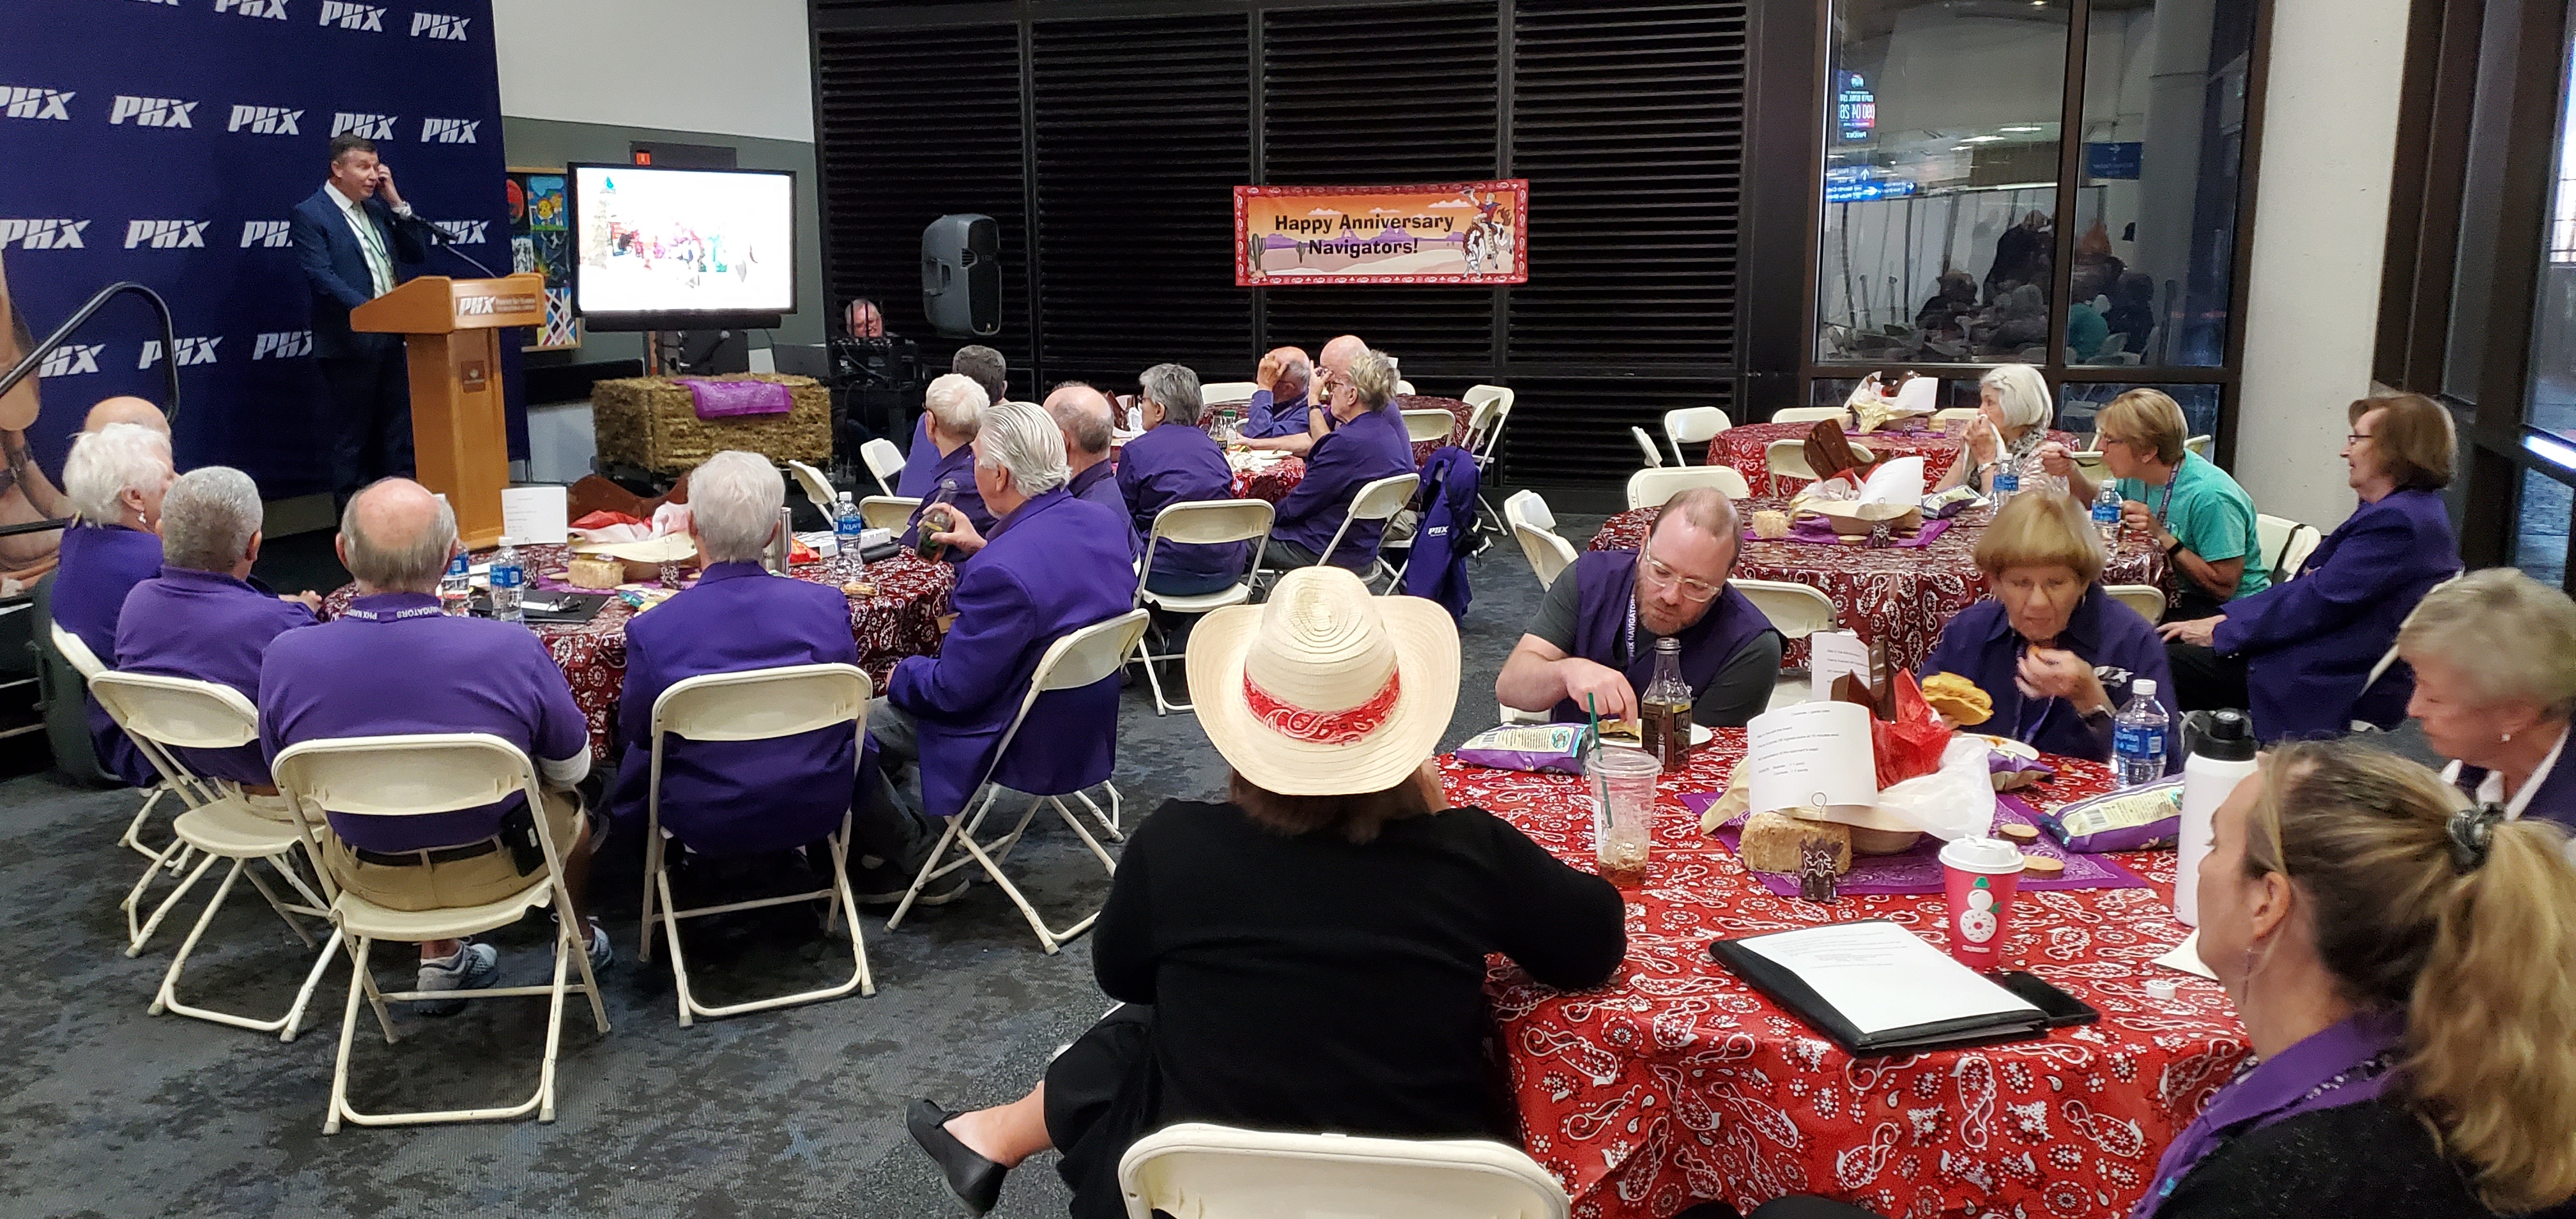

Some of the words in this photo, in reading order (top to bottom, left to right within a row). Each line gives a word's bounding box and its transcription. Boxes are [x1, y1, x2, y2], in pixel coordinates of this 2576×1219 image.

[319, 1, 388, 32] PHX
[411, 12, 471, 42] PHX
[110, 95, 199, 128] PHX
[228, 104, 306, 135] PHX
[330, 112, 400, 141] PHX
[420, 118, 482, 144] PHX
[0, 219, 93, 250] PHX
[124, 220, 211, 249] PHX
[240, 220, 293, 248] PH
[1275, 215, 1333, 234] Happy
[1339, 213, 1454, 232] Anniversary
[1310, 237, 1418, 259] Navigators!
[458, 296, 496, 316] PHX
[38, 343, 106, 378] HX
[138, 335, 224, 370] PHX
[1428, 525, 1450, 535] PHX
[364, 611, 378, 620] PHX
